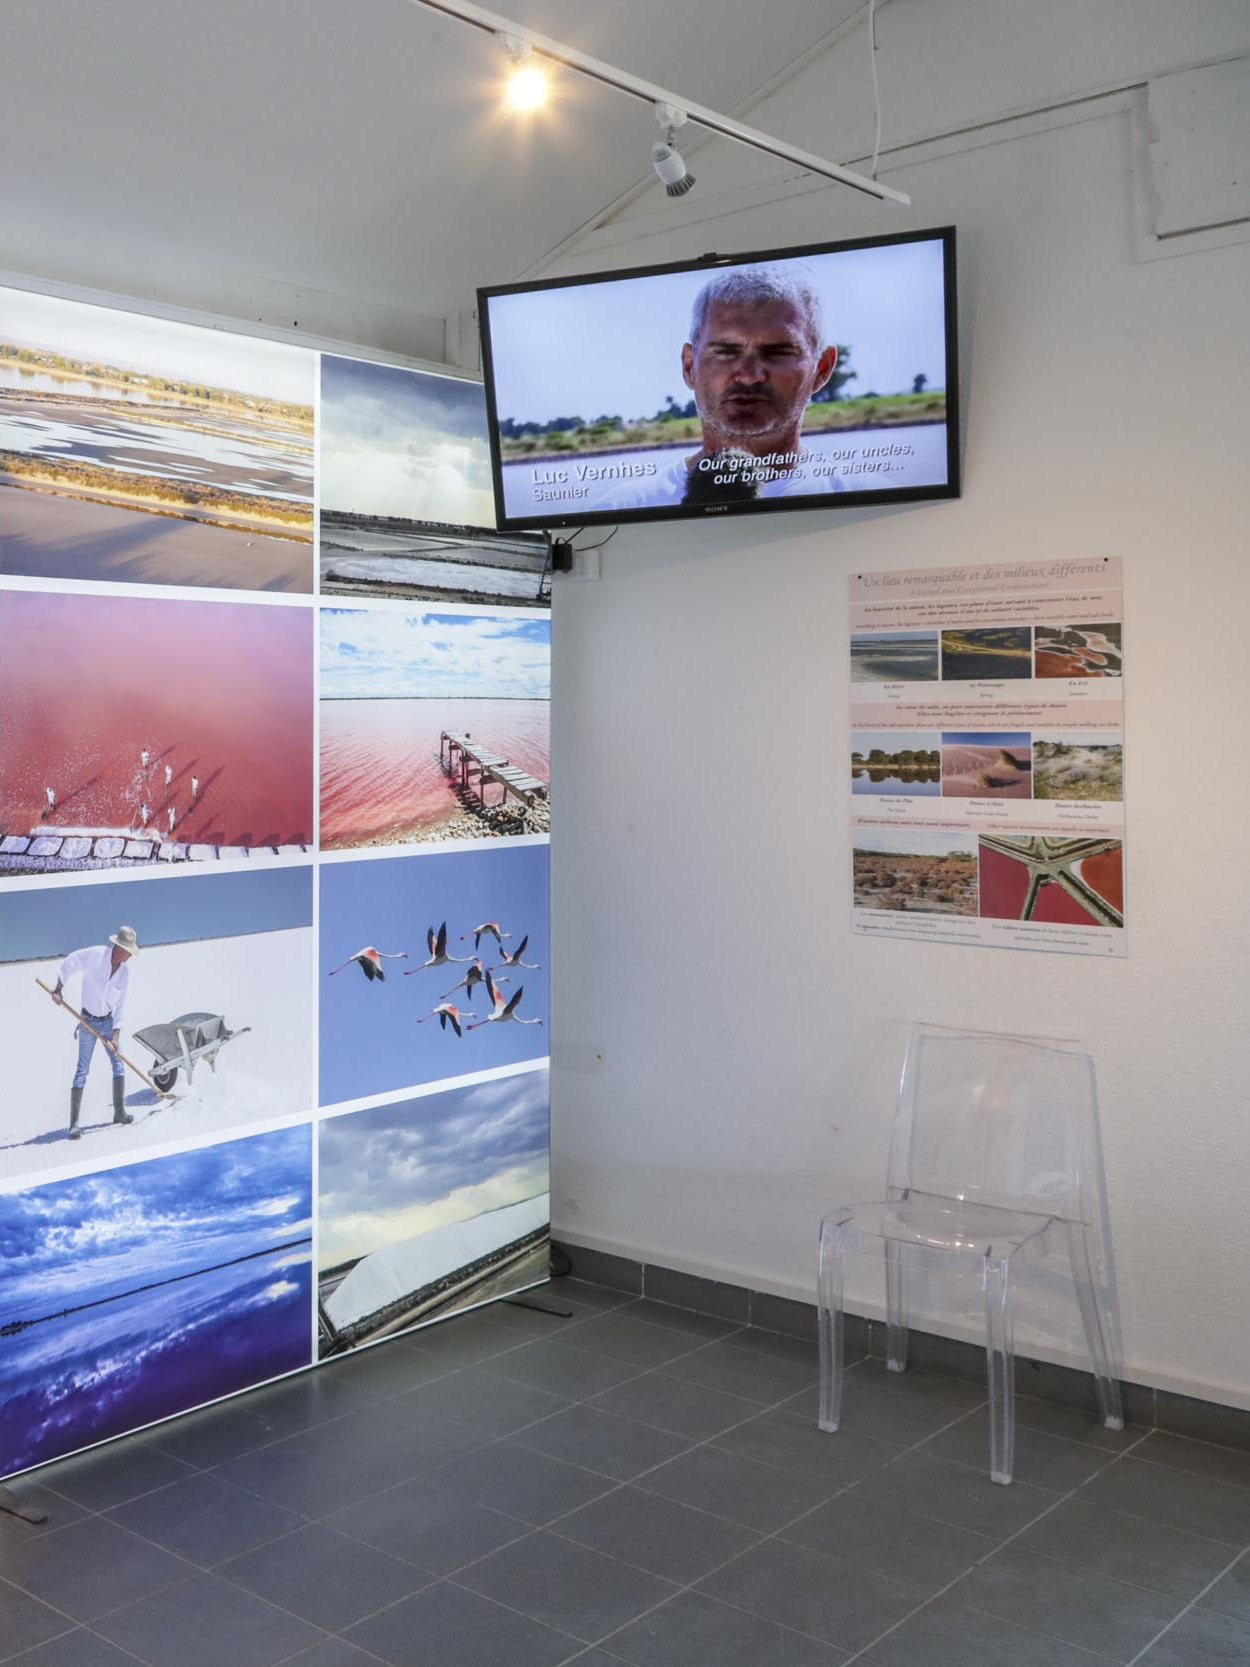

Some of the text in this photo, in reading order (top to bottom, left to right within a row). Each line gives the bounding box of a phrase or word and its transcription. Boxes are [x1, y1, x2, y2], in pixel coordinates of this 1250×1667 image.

[699, 443, 916, 471] Our grandfathers, our uncles,
[532, 460, 657, 485] Luc Vernhes
[713, 461, 906, 485] our brothers, our sisters...
[533, 486, 590, 502] Saunier
[705, 505, 729, 513] SONY
[863, 577, 880, 588] Un
[882, 575, 901, 586] lieu
[903, 570, 967, 586] remarquable
[968, 571, 980, 580] et
[982, 568, 1001, 580] des
[1003, 566, 1047, 578] milieux
